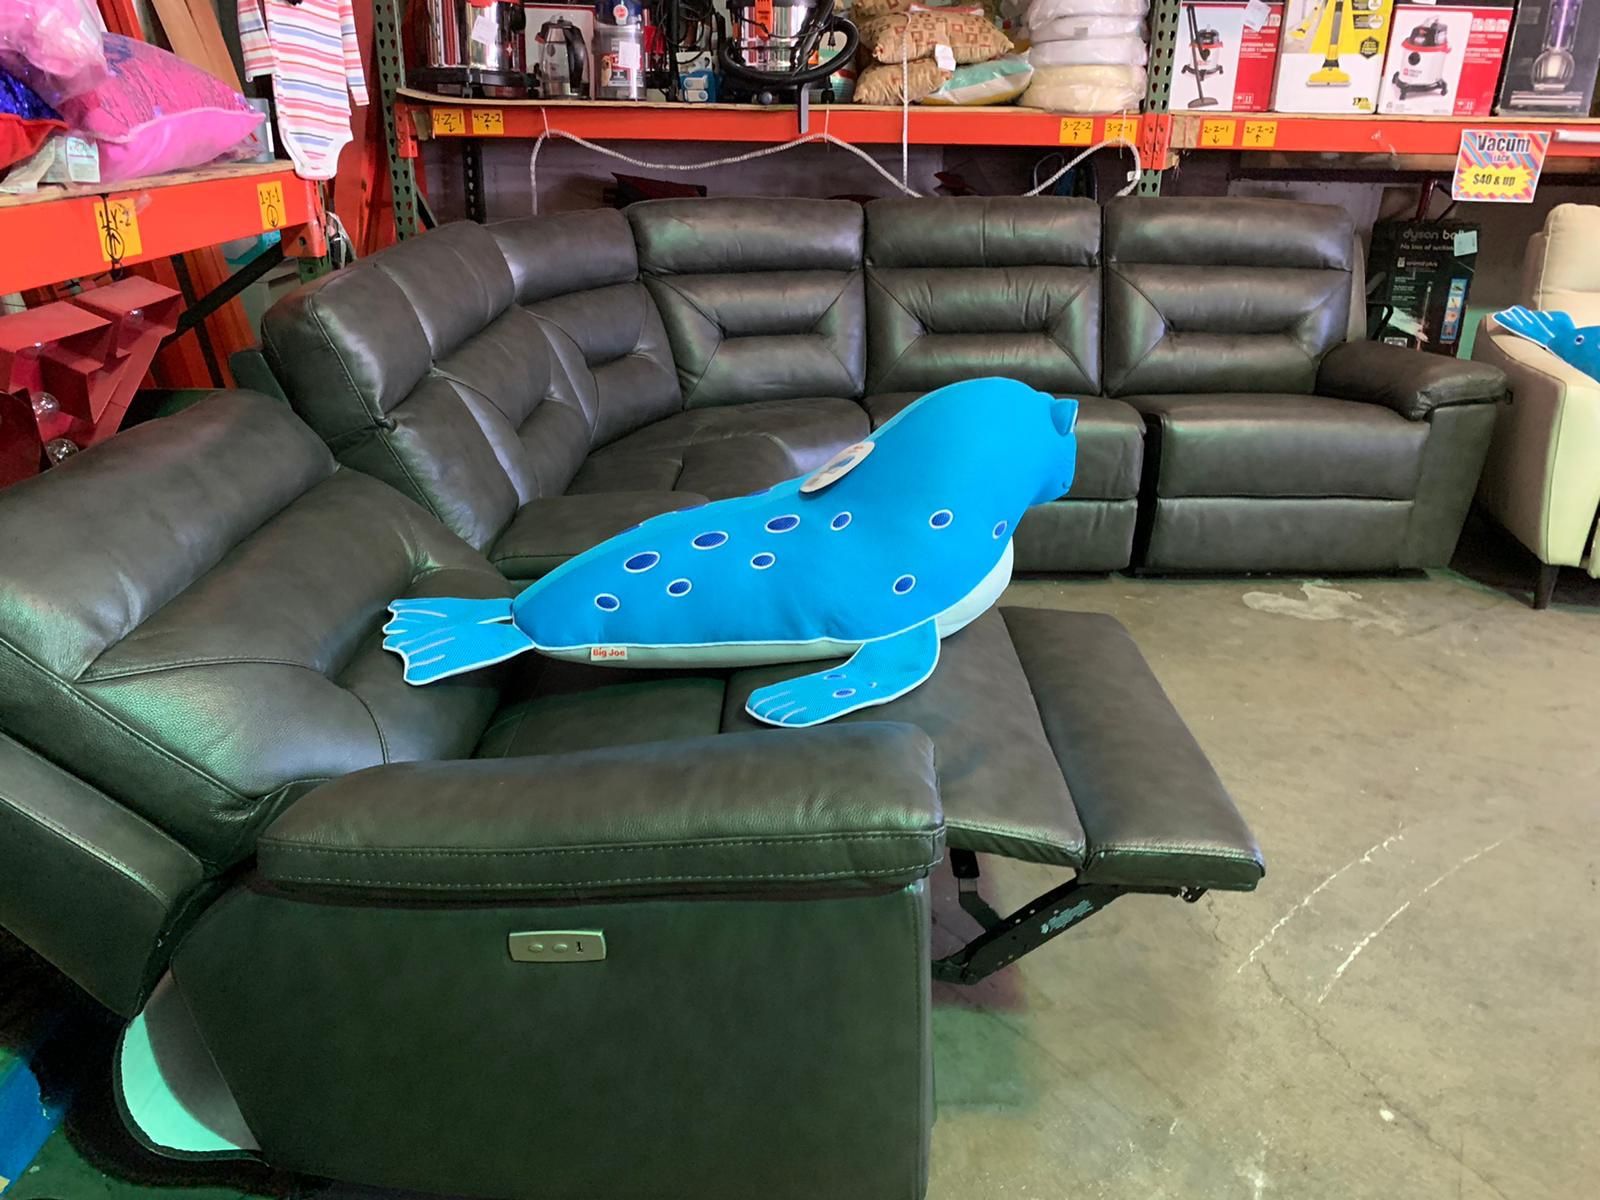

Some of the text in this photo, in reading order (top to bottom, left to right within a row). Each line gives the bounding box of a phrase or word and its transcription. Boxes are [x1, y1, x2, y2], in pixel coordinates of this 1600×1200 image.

[1477, 135, 1531, 153] Vacum
[1472, 173, 1492, 186] $40
[1502, 176, 1516, 186] up
[1403, 228, 1439, 241] dyson
[593, 647, 625, 657] Big Joe
